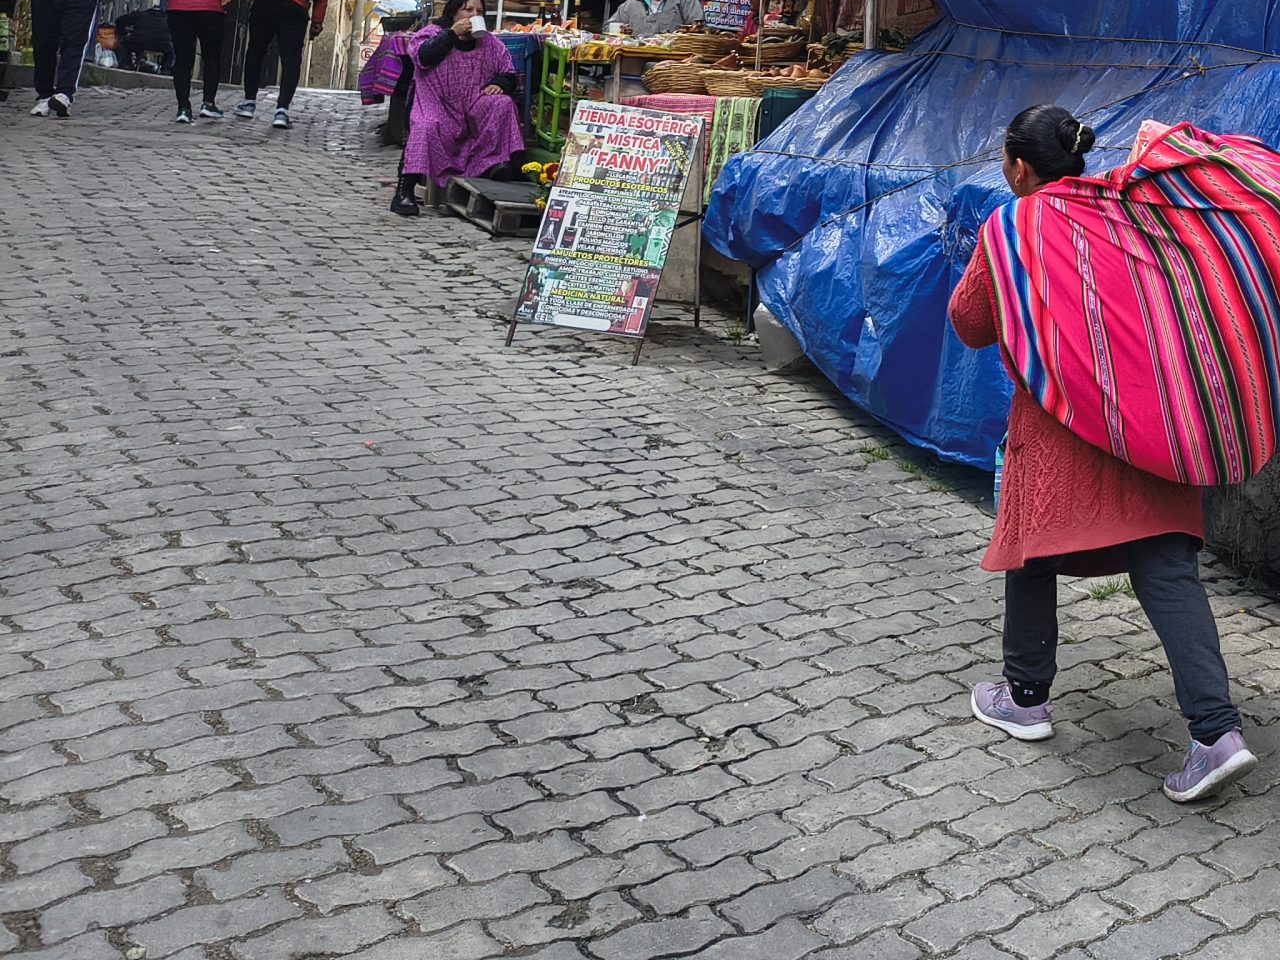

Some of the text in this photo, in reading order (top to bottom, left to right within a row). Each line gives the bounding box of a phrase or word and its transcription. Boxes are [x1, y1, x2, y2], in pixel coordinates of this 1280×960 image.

[579, 108, 699, 137] TIENDA ESOTÉRICA
[607, 133, 660, 151] MISTICA
[590, 148, 670, 174] “FANNY”
[573, 176, 621, 188] PRODUCTOS
[549, 249, 649, 267] AMULETOS PROTECTORES
[550, 288, 626, 304] MEDICINA NATURAL
